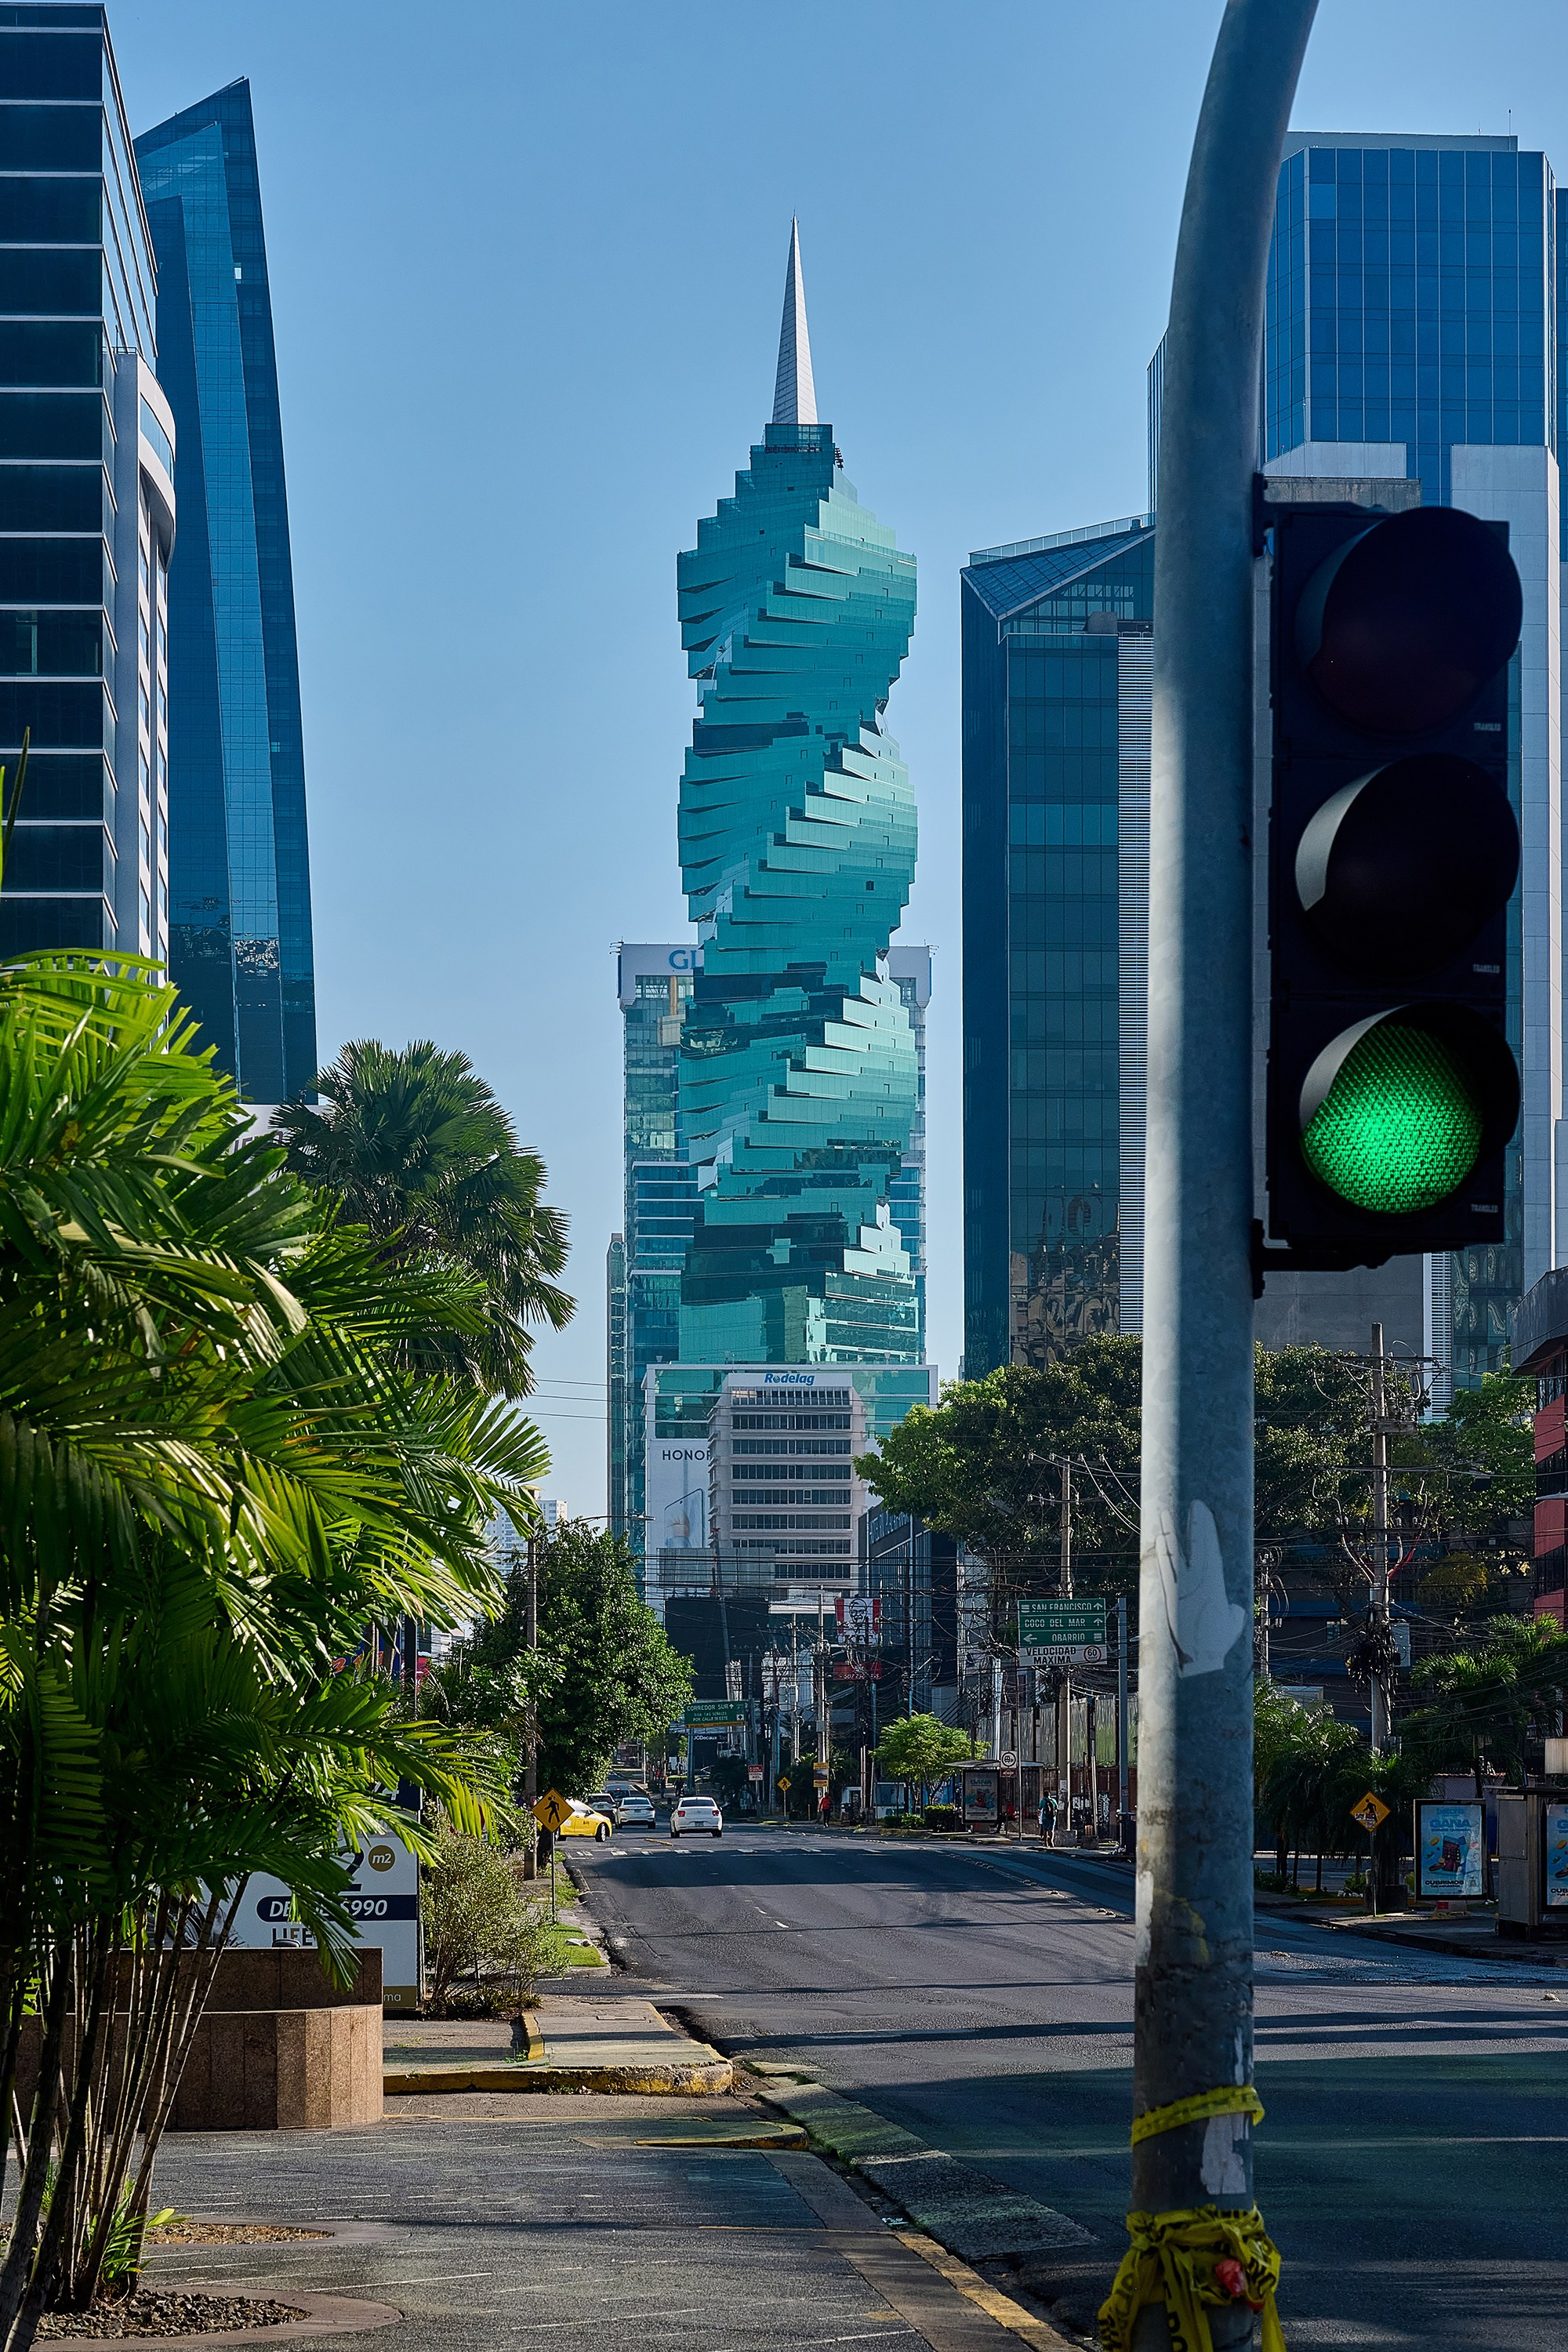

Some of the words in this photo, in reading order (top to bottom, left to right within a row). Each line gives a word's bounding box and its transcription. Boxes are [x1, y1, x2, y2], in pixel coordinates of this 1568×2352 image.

[764, 1373, 815, 1385] Rodelag
[1050, 1602, 1091, 1612] FRANCISCO
[1025, 1619, 1044, 1628] COCO
[1050, 1618, 1064, 1628] DEL
[1069, 1618, 1085, 1627] MAR
[1052, 1633, 1085, 1642] OBARRIO
[1026, 1646, 1076, 1656] VELOCIDAD
[1033, 1655, 1072, 1664] MAXIMA
[372, 1853, 391, 1864] m2
